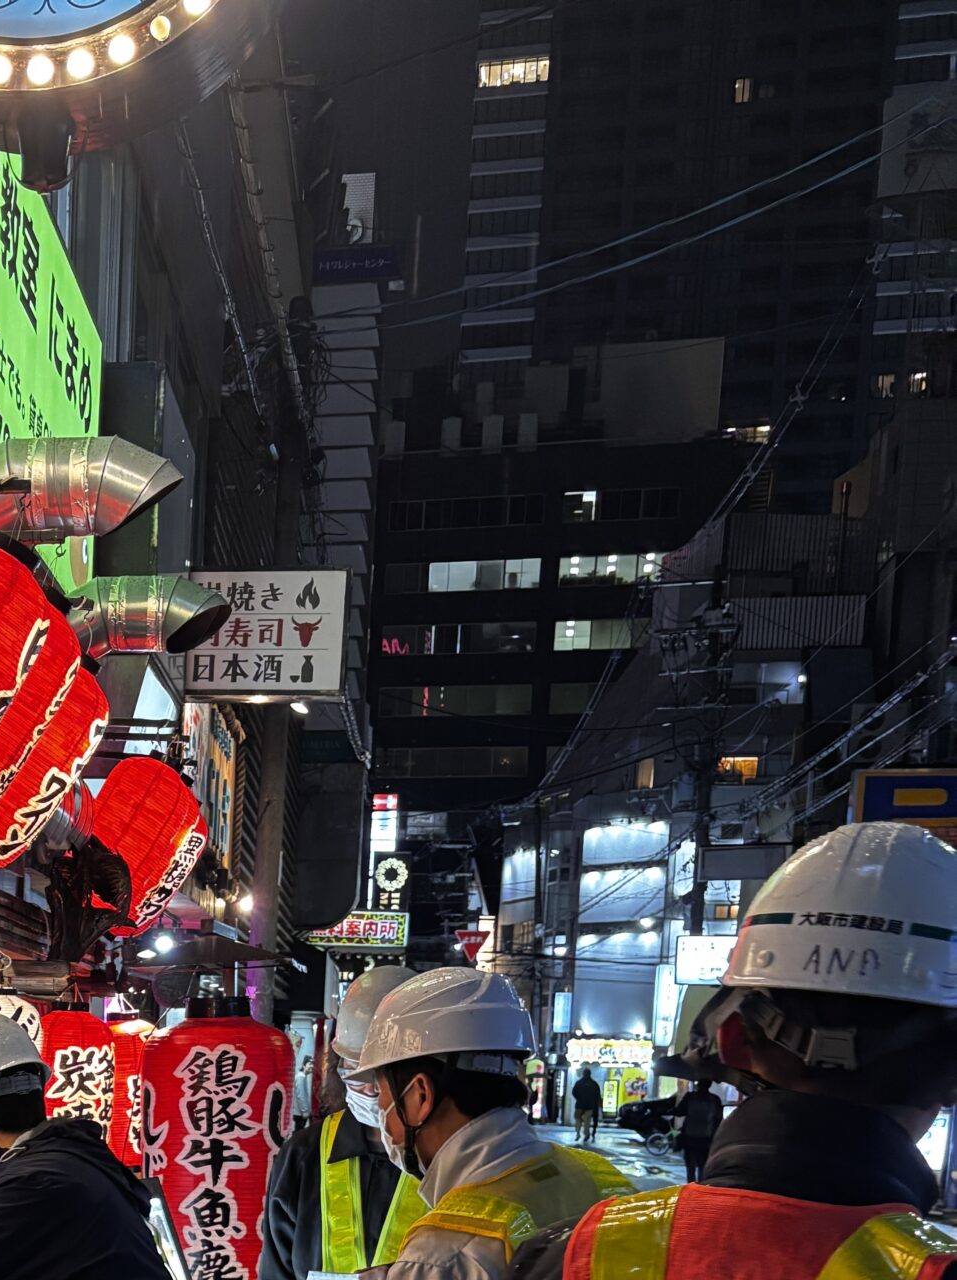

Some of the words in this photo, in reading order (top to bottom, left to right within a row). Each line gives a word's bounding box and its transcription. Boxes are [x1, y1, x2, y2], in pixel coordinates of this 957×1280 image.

[48, 271, 92, 433] にまめ
[208, 617, 284, 648] 寿司
[192, 653, 284, 684] 日本酒
